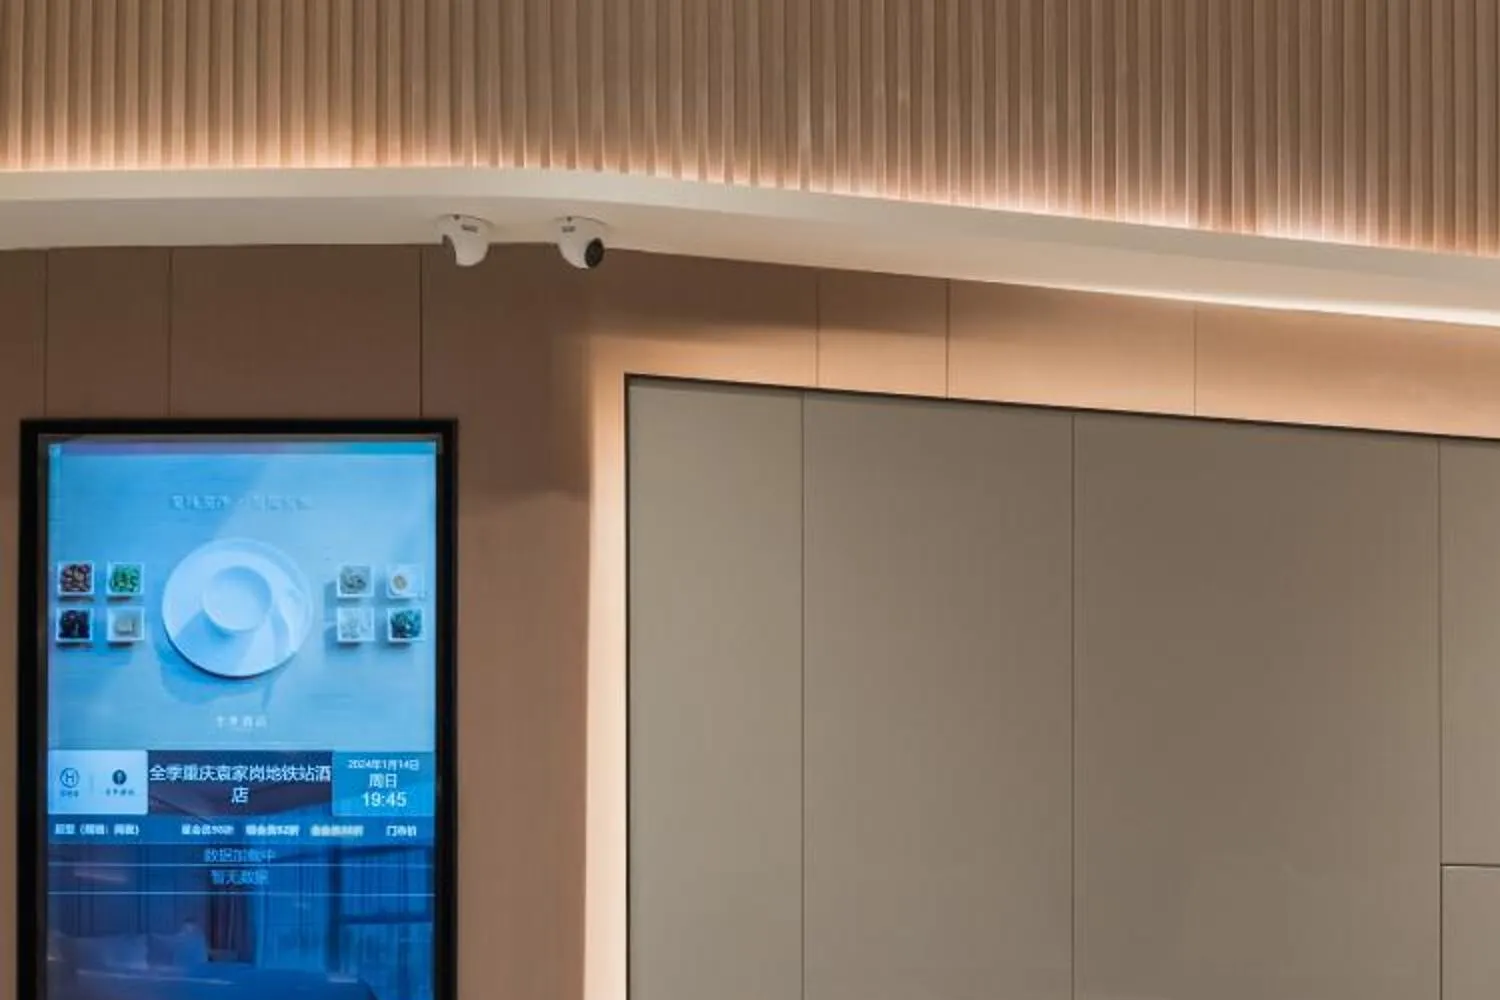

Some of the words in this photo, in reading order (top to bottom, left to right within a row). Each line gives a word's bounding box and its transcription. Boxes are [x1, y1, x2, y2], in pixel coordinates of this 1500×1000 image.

[149, 764, 332, 783] 全季重庆袁家岗地铁站酒
[369, 773, 397, 789] 周日
[231, 787, 249, 803] 店
[361, 791, 407, 808] 19:45
